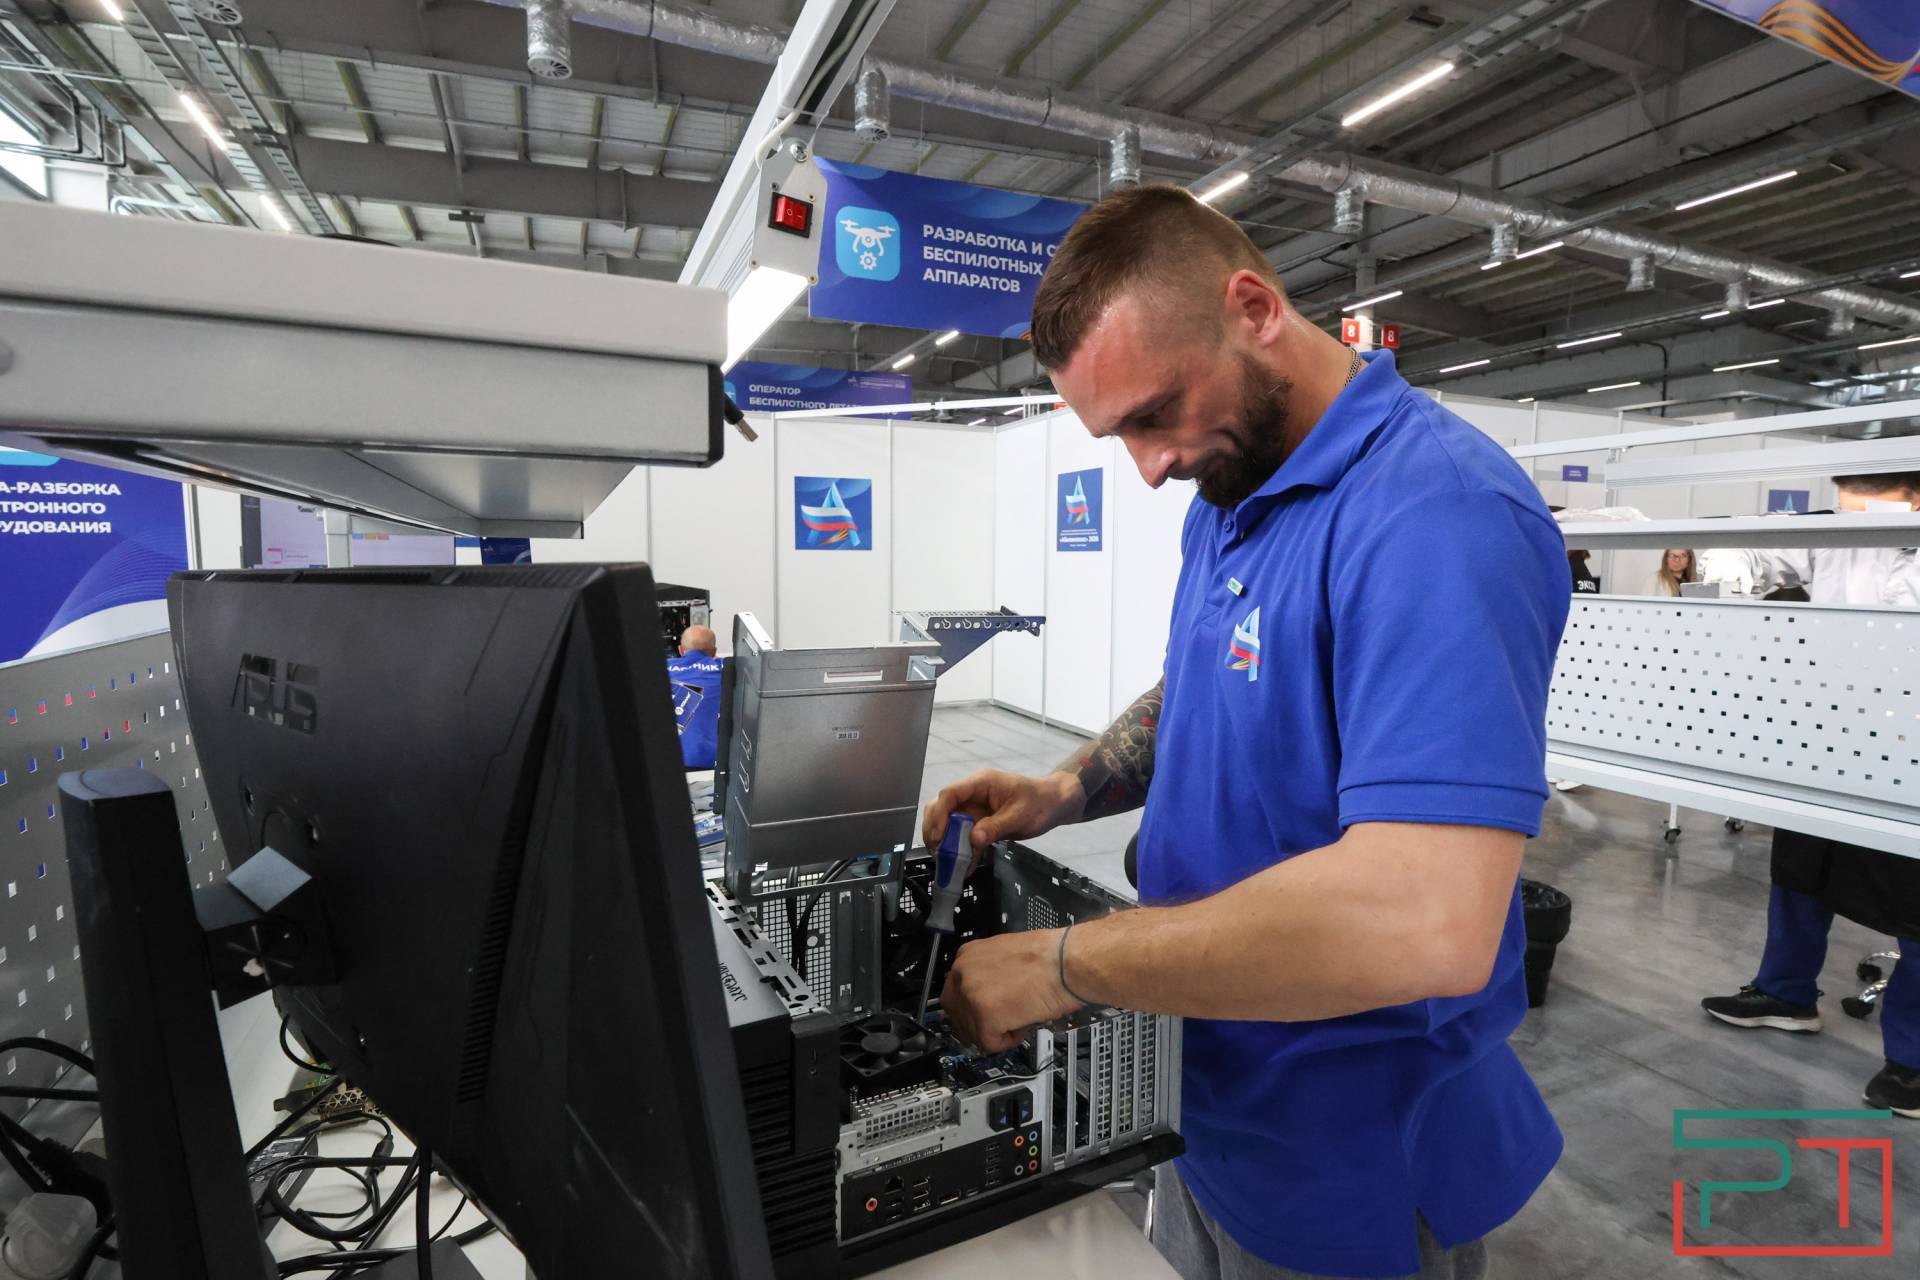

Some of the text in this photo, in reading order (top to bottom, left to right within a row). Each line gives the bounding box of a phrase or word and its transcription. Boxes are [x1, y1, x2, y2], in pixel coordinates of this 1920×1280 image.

[923, 225, 1027, 253] РАЗРАБОТКА
[1032, 241, 1042, 255] И
[923, 246, 1043, 276] БЕСПИЛОТНЫХ
[923, 268, 1020, 293] АППАРАТОВ
[1347, 325, 1355, 337] 8
[1388, 330, 1394, 342] 8
[749, 384, 801, 395] ОПЕРАТОР
[749, 397, 826, 409] БЕСПИЛОТНОГО
[0, 501, 106, 514] ТРОННОГО
[0, 520, 112, 534] УДОВАНИЯ
